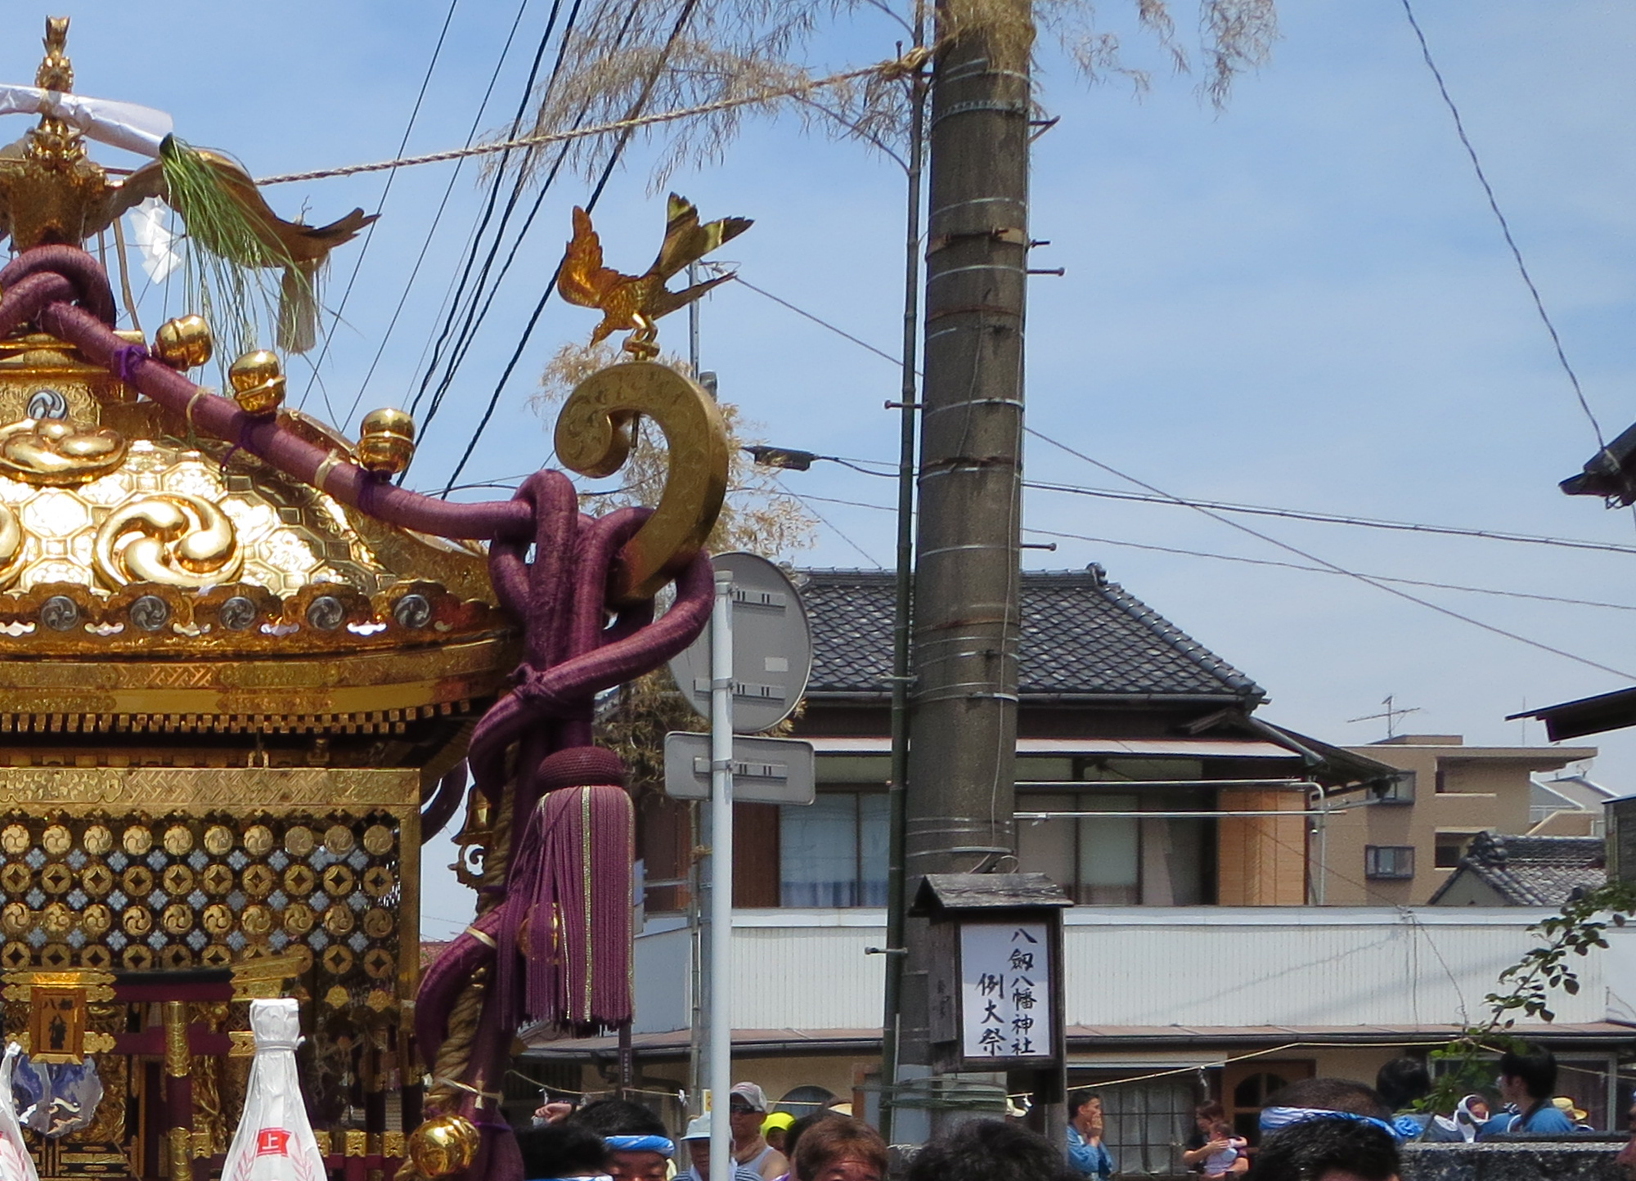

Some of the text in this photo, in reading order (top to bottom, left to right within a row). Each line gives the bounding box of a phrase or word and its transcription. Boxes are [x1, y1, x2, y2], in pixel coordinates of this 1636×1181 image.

[974, 972, 1006, 1056] 例大祭
[262, 1133, 280, 1150] 上
